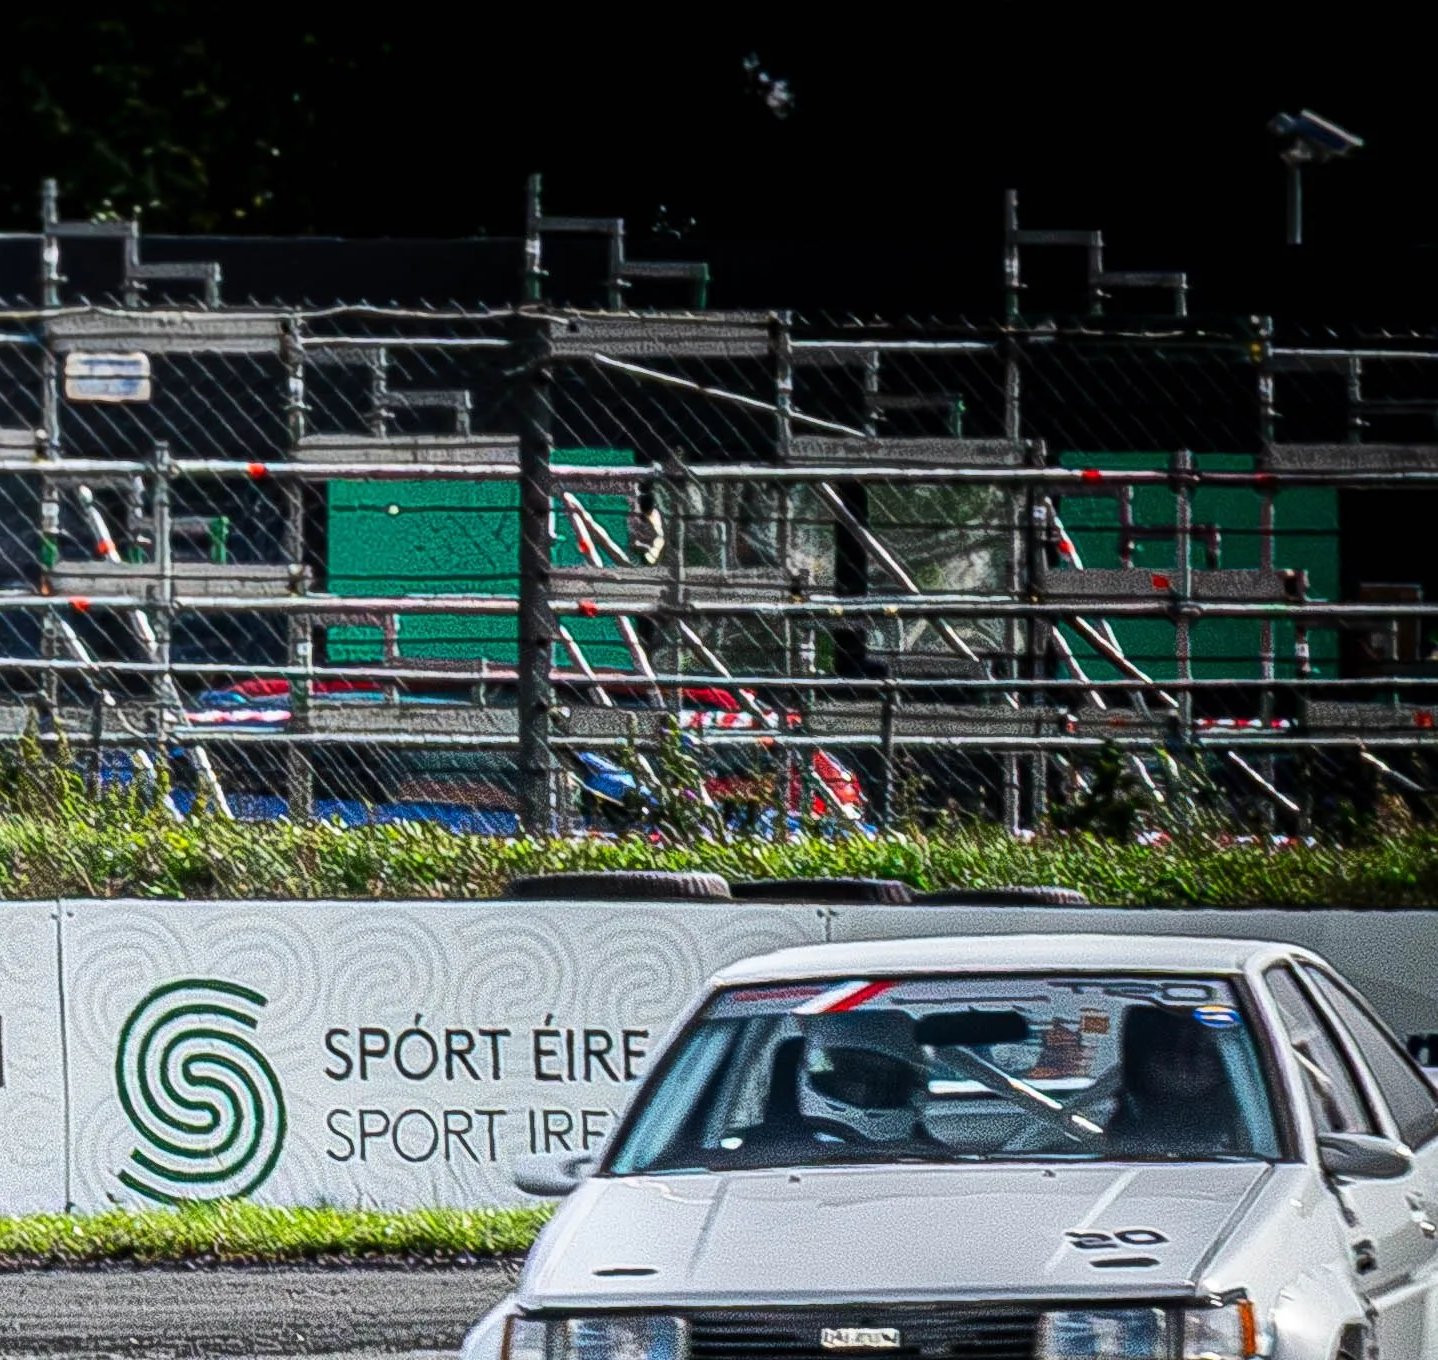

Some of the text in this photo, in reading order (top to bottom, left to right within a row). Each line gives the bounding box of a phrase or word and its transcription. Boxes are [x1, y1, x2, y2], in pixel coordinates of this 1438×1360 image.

[323, 1012, 512, 1083] SPÓRT
[325, 1108, 620, 1164] SPORT IRE
